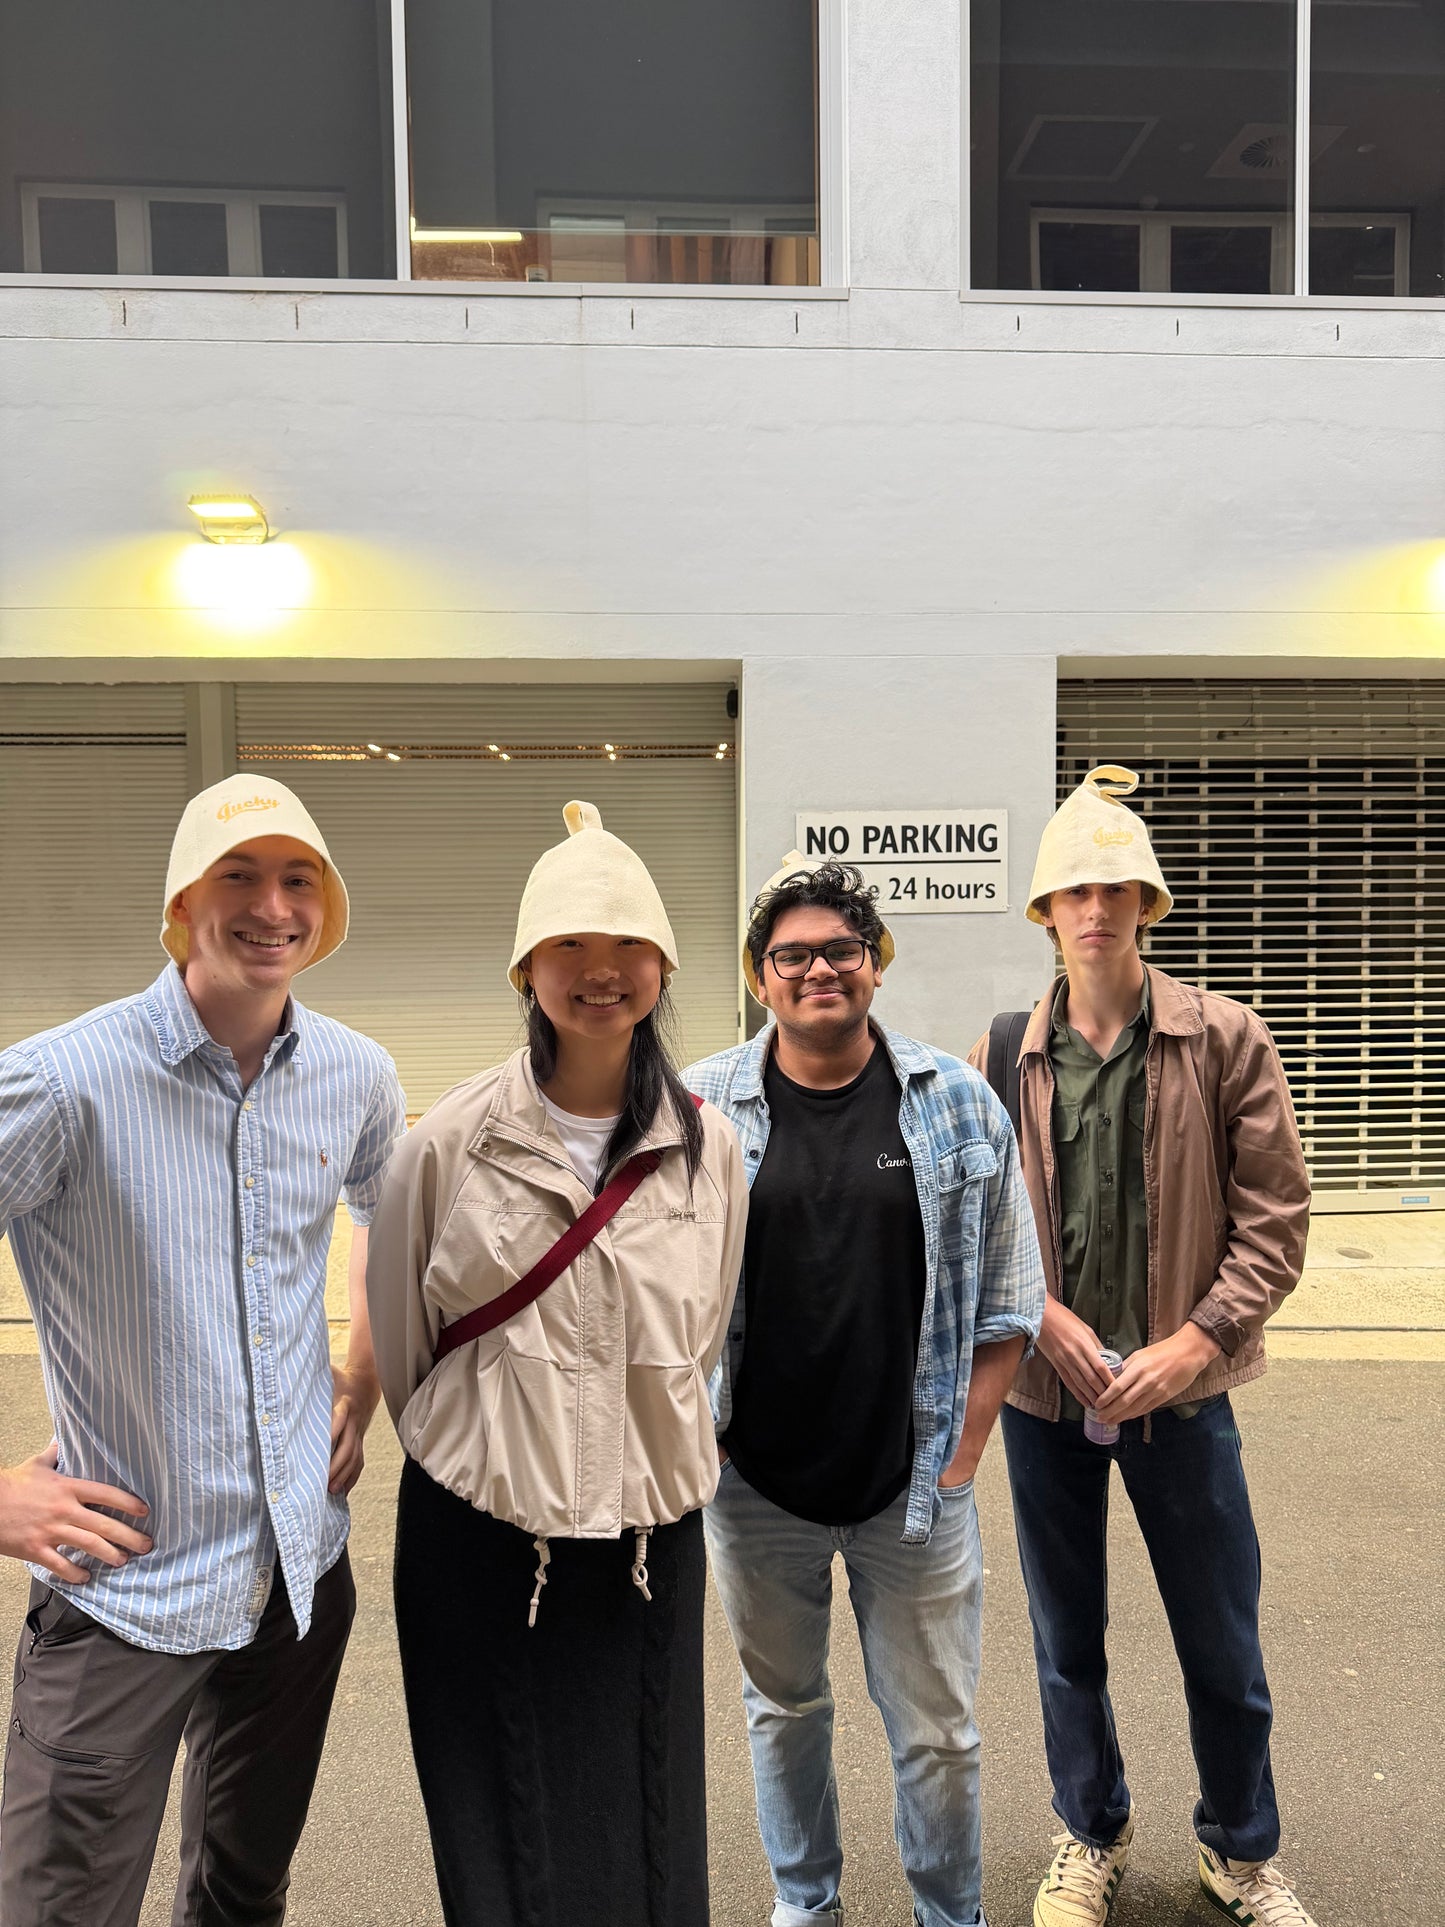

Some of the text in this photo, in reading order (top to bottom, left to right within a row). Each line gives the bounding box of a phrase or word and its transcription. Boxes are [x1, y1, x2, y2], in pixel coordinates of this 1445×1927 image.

[806, 824, 998, 854] NO PARKING
[889, 877, 917, 900] 24
[926, 877, 996, 899] hours
